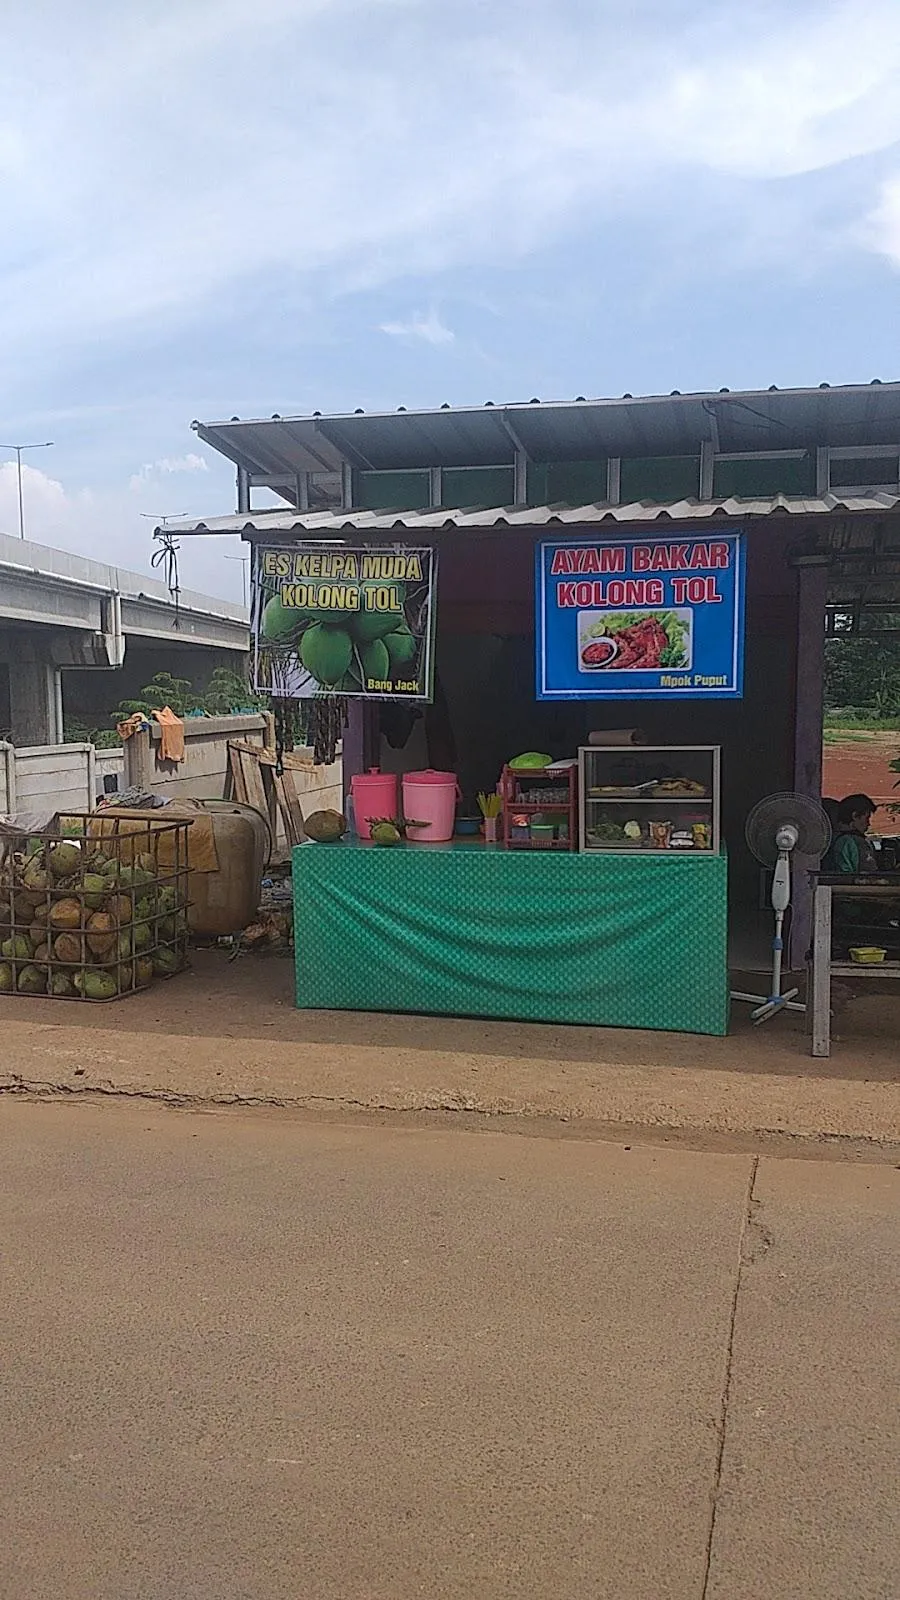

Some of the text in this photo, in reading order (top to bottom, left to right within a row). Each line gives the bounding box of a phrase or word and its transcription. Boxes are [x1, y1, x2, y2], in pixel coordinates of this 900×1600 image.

[264, 552, 422, 580] ES KELPA MUDA
[551, 543, 729, 575] AYAM BAKAR
[281, 584, 402, 611] KOLONG TOL
[558, 576, 722, 608] KOLONG TOL
[368, 679, 419, 692] Bang Jack
[660, 675, 727, 687] Mpok Puput
